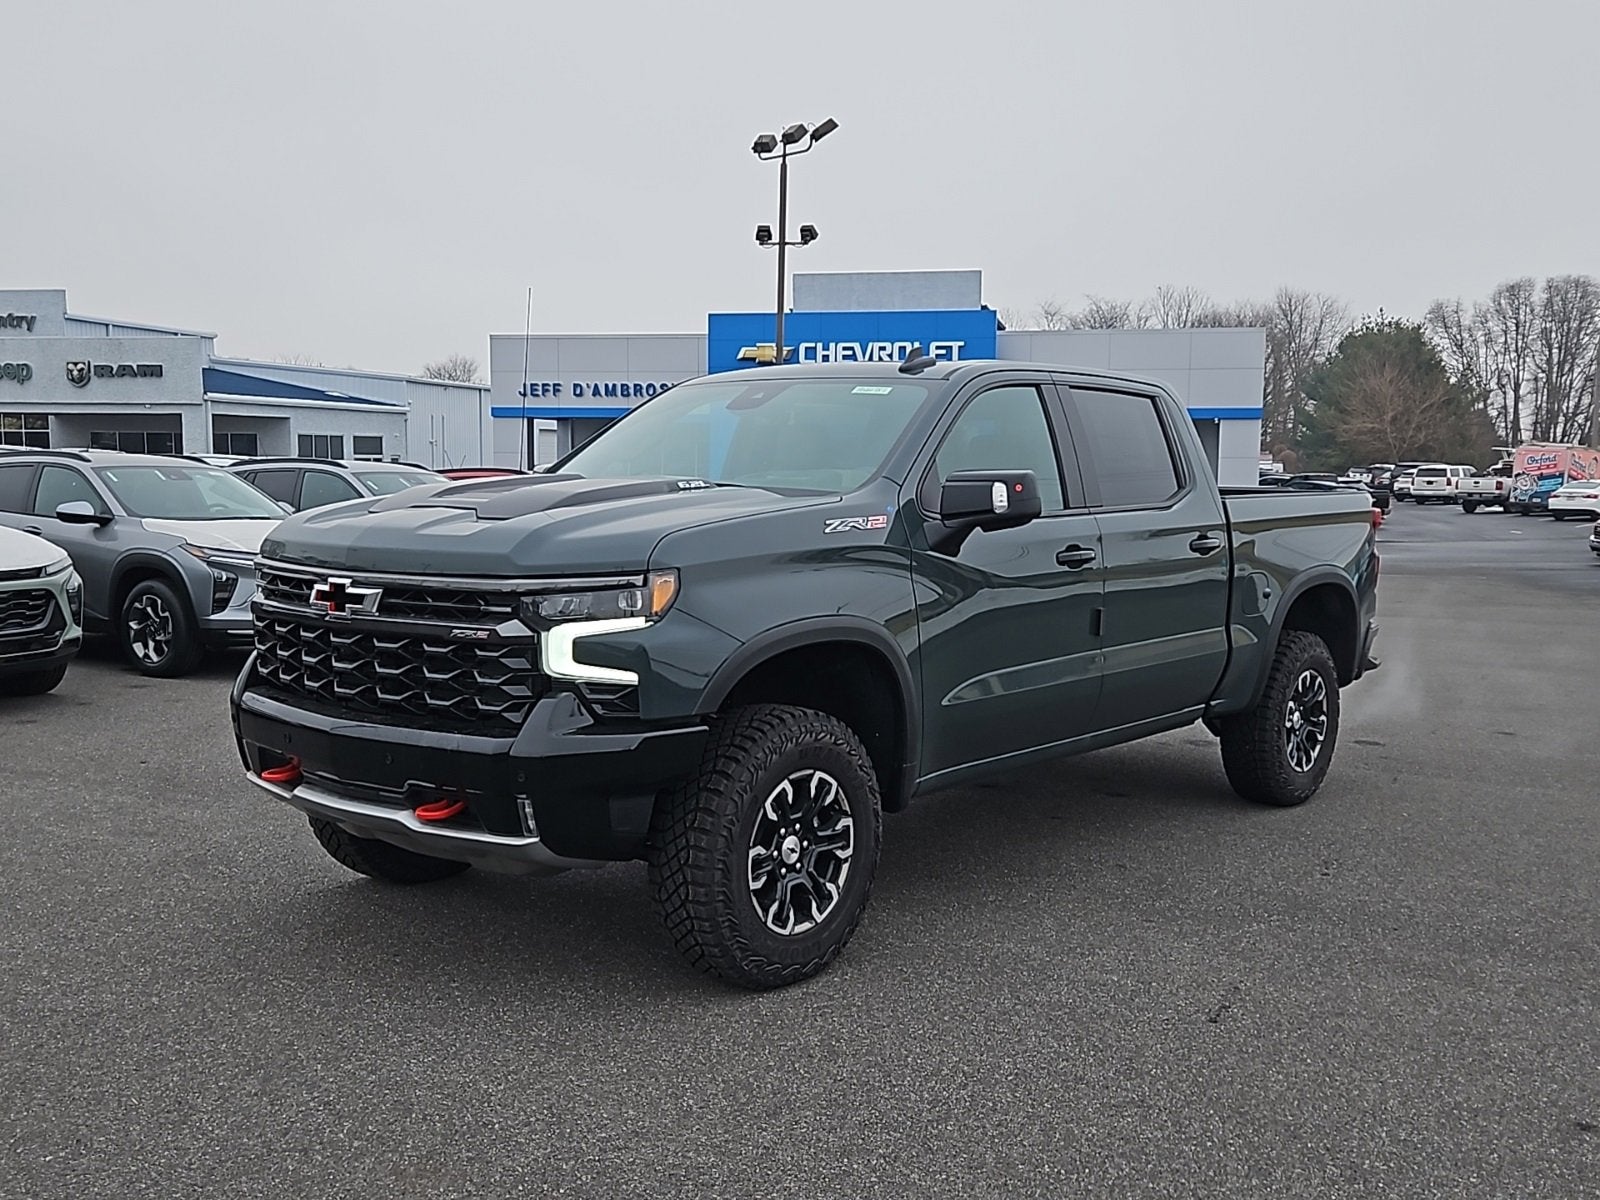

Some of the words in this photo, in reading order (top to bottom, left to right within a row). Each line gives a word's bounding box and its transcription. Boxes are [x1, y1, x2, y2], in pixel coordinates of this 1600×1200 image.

[93, 364, 164, 378] RAM
[518, 383, 563, 397] JEFF
[572, 383, 676, 398] D'AMBROS
[824, 515, 888, 534] ZR2
